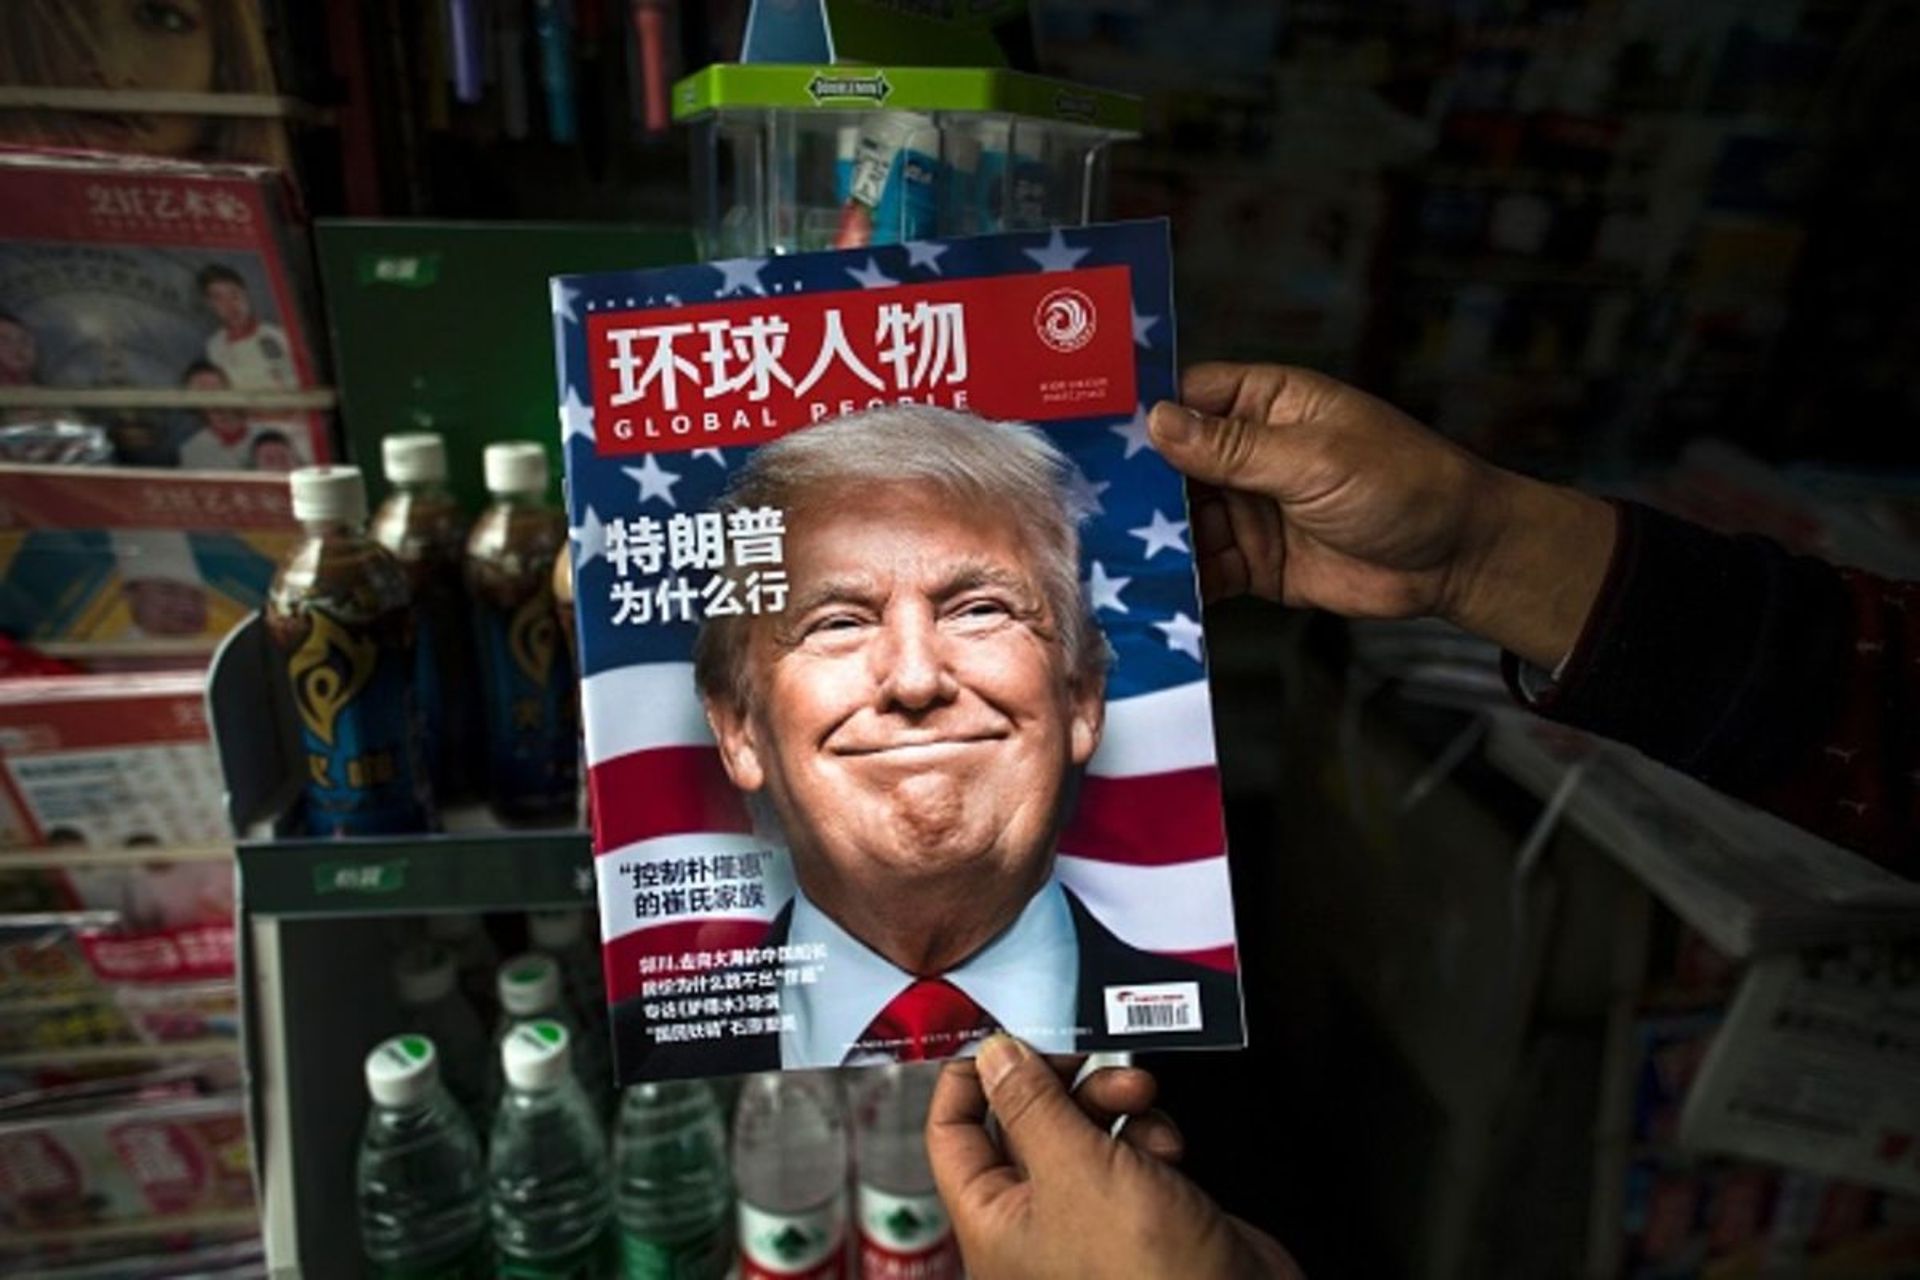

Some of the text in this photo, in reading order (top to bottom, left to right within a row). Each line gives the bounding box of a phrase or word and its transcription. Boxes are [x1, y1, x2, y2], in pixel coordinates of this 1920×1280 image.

[607, 301, 968, 411] 环球人物
[613, 407, 778, 440] GLOBAL
[606, 506, 787, 576] 特朗普
[610, 571, 789, 626] 为什么行
[634, 884, 766, 918] 的崔氏家族
